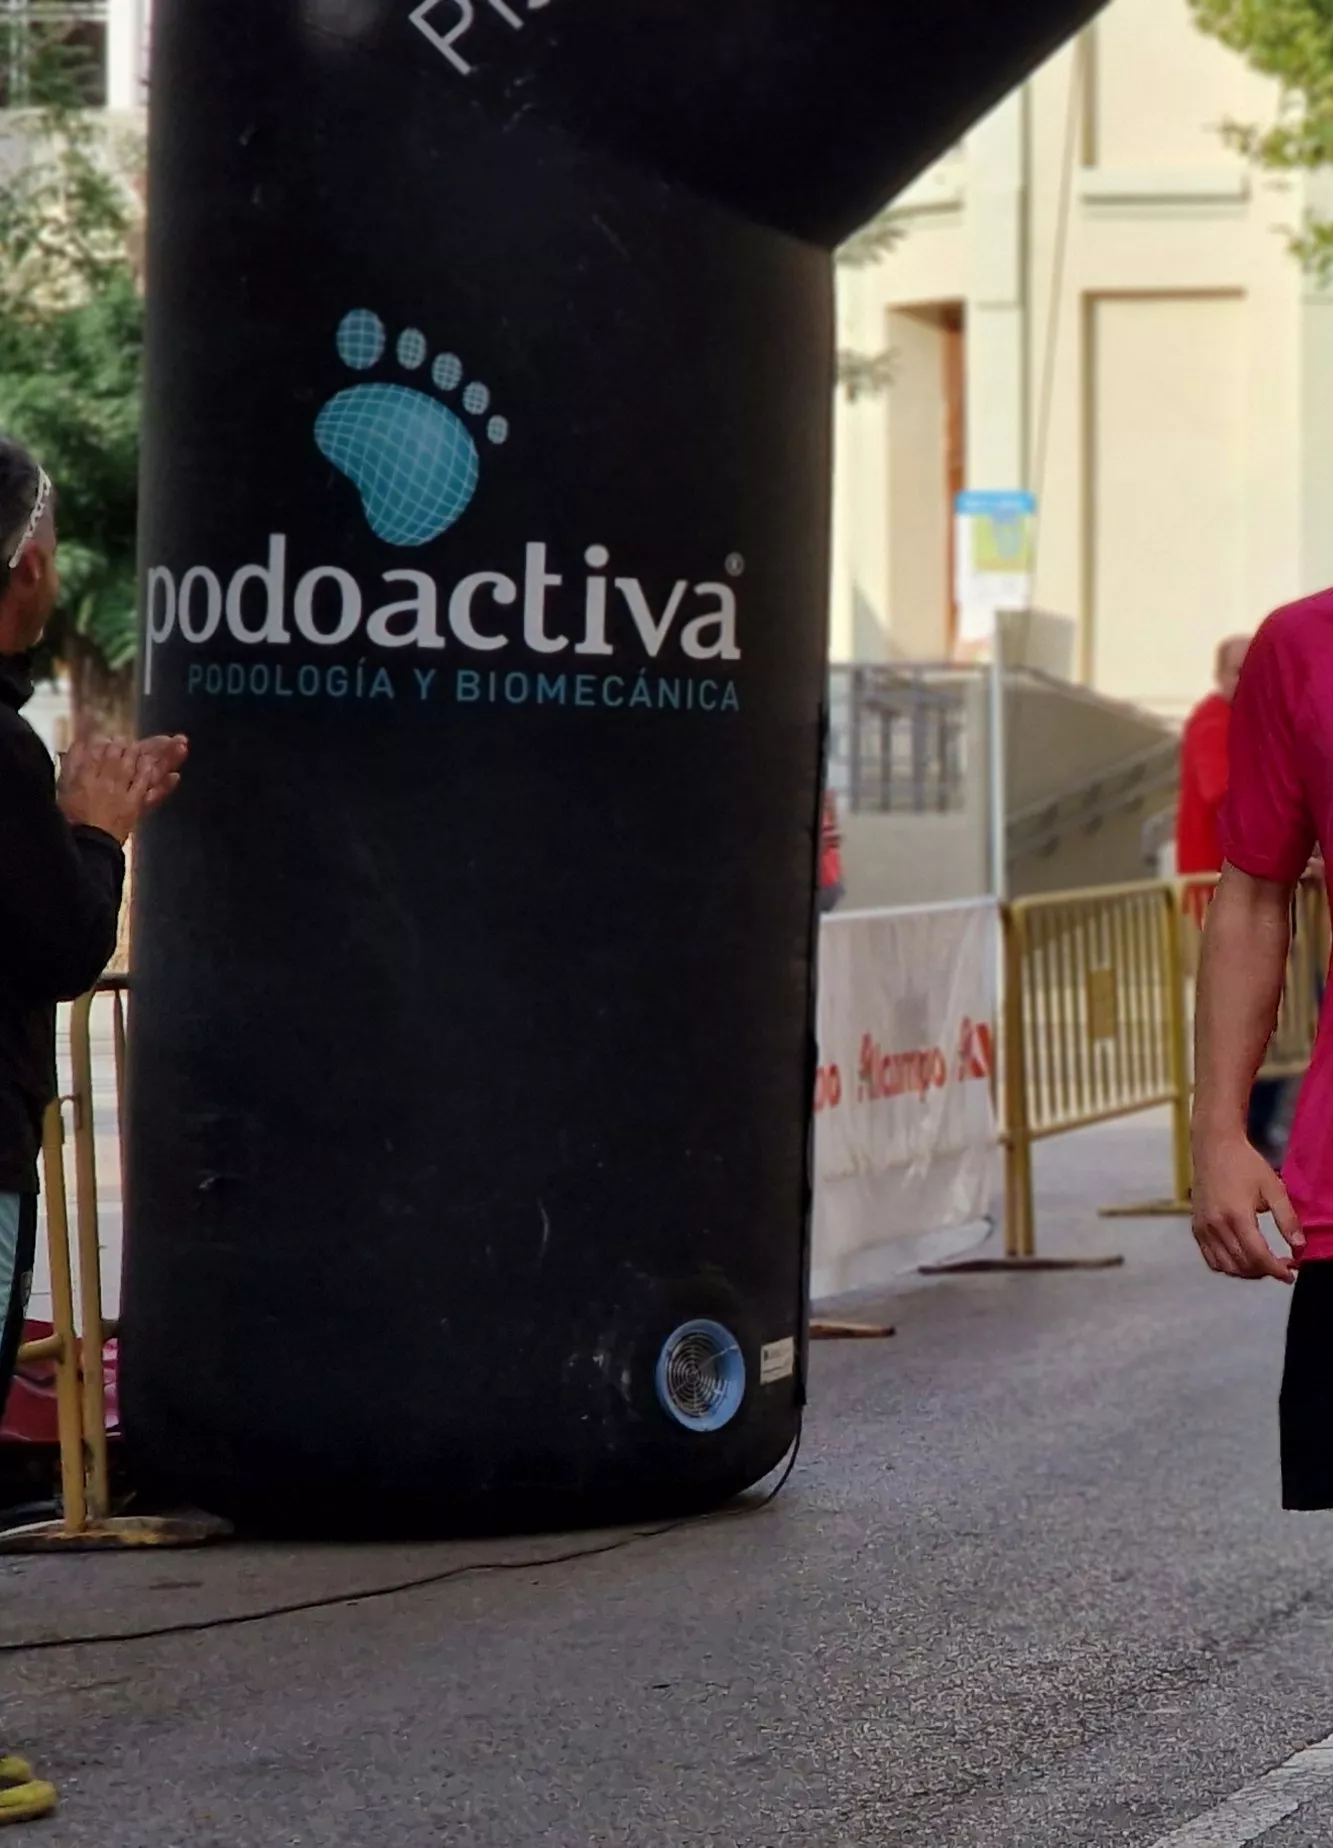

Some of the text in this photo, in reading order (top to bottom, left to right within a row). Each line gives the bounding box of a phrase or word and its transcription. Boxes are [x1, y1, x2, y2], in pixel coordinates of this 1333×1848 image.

[188, 657, 741, 712] PODOLOGÍA Y BIOMECÁNICA
